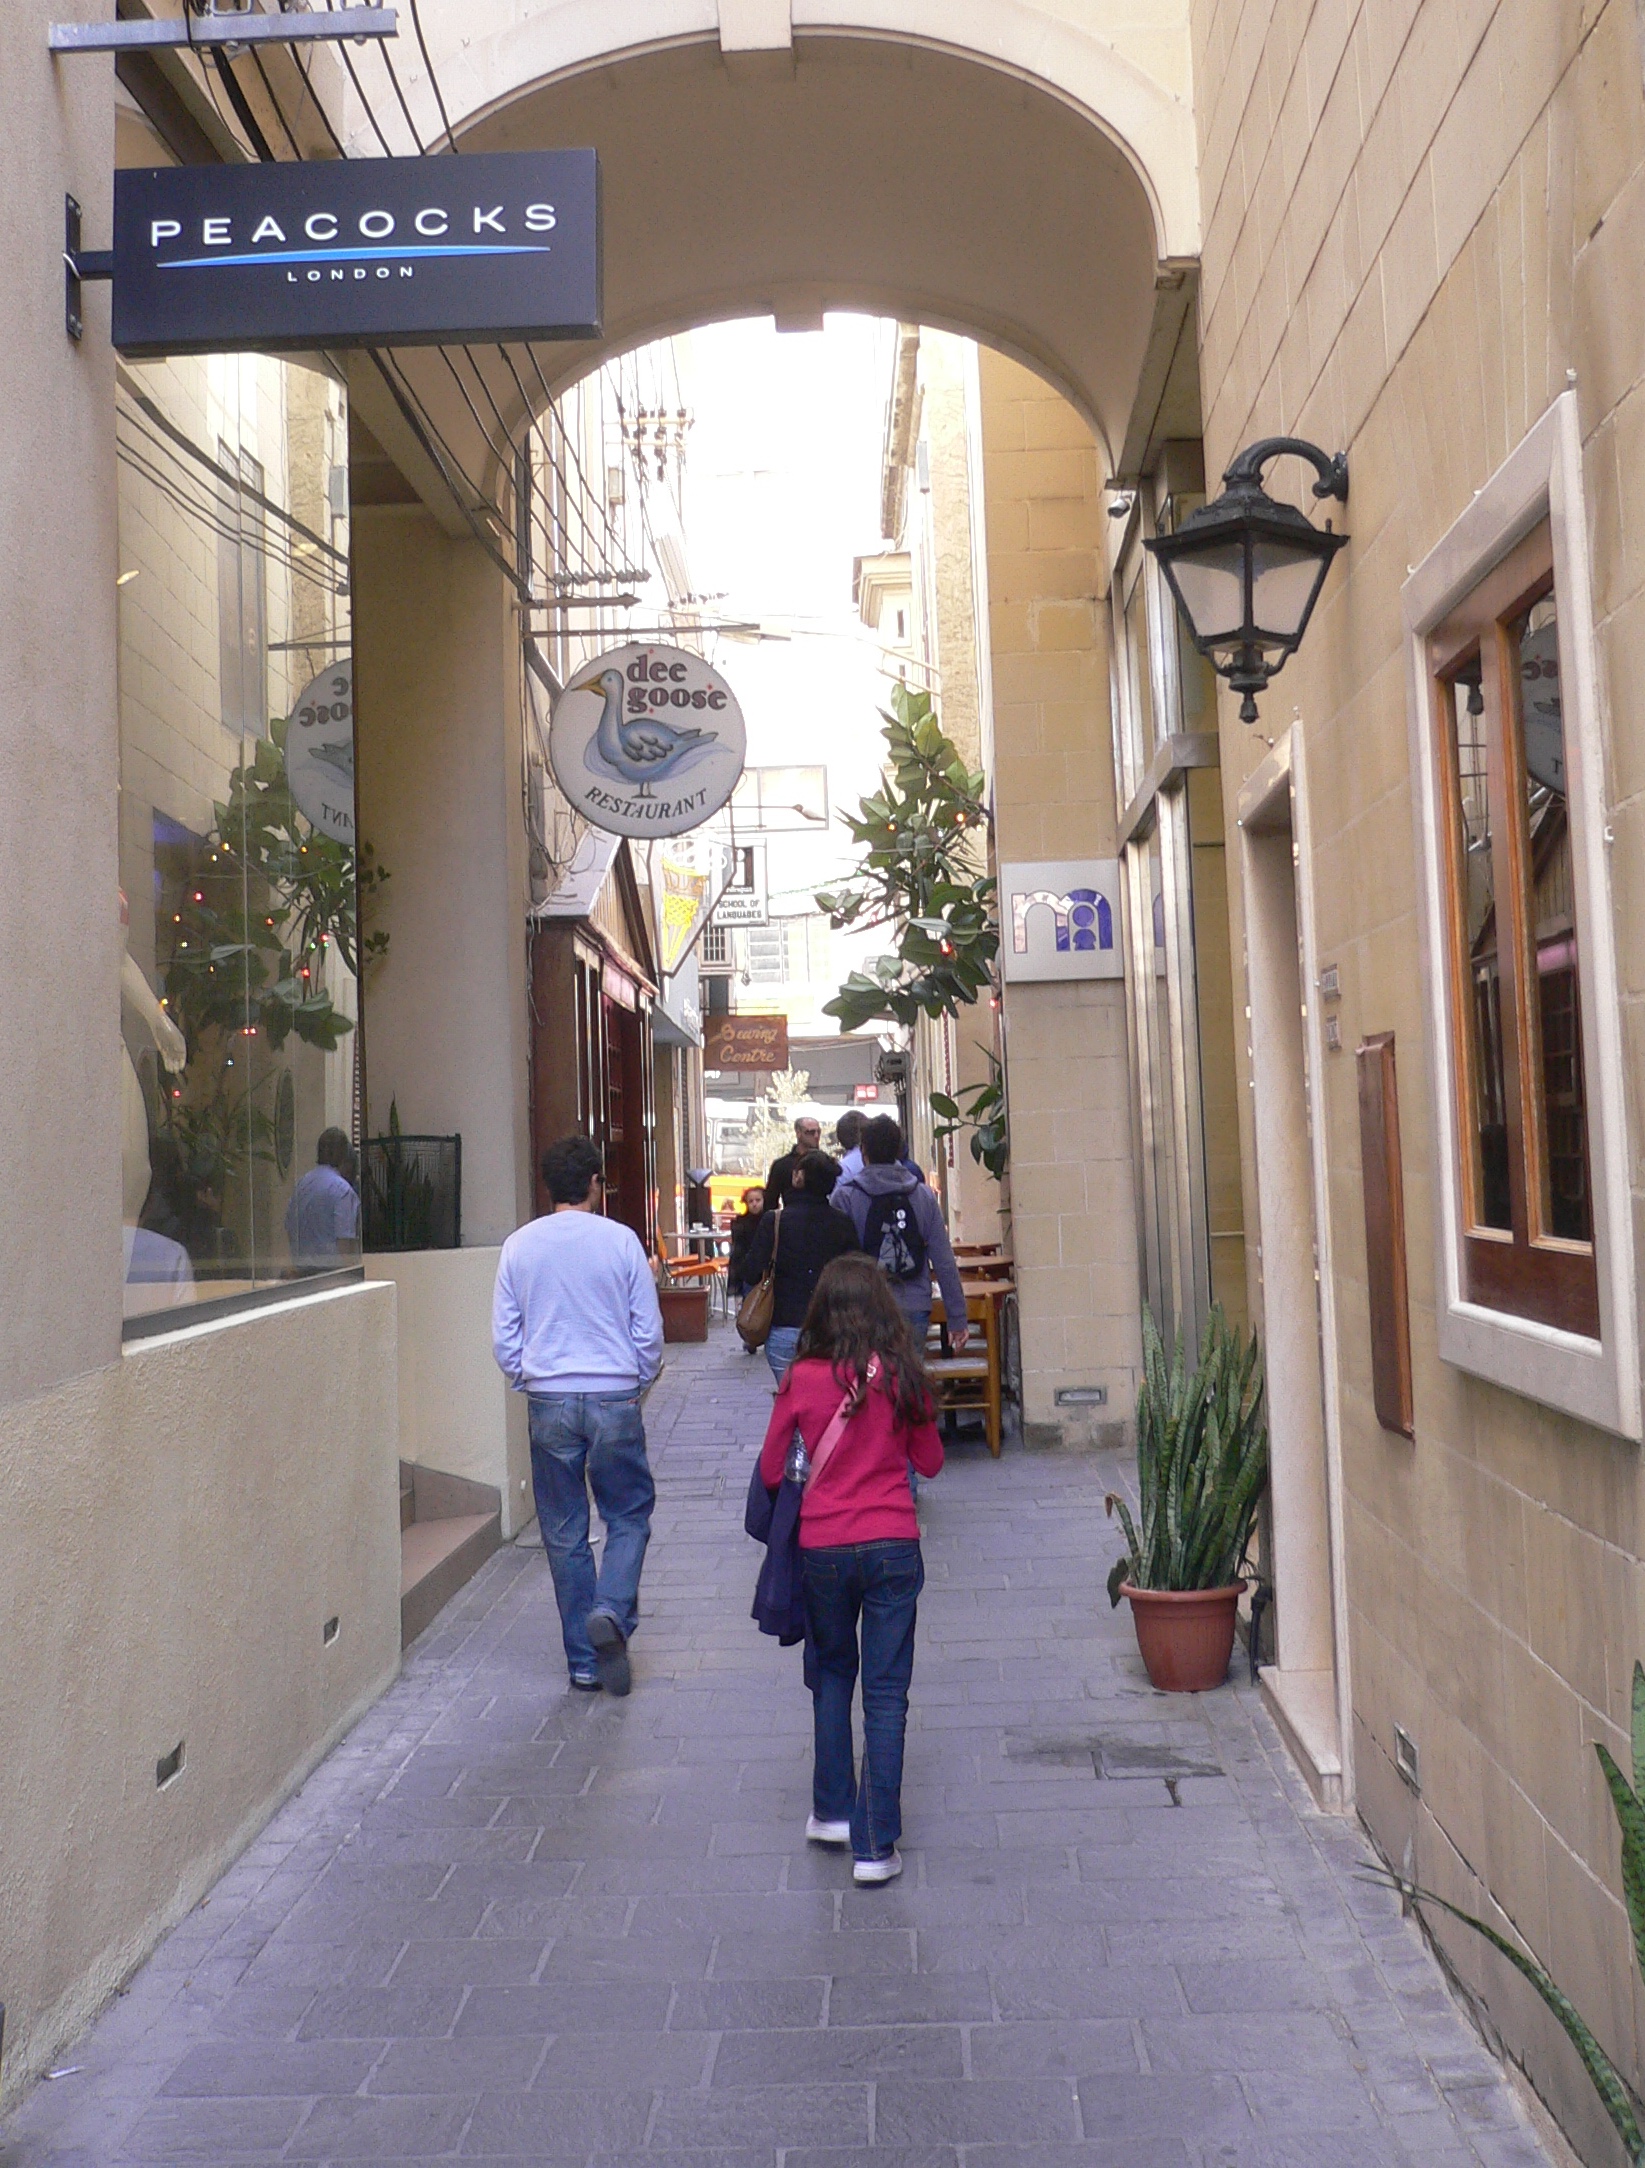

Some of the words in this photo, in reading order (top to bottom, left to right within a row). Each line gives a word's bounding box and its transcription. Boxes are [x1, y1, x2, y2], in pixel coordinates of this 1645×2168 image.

[150, 203, 558, 248] PEACOCKS
[286, 266, 415, 283] LONDON
[626, 654, 688, 683] dee
[626, 687, 728, 714] goose
[584, 785, 708, 820] RESTAURANT
[716, 910, 762, 920] LANGUAGES
[719, 899, 748, 909] SCHOOL
[749, 899, 761, 908] OF
[720, 1044, 777, 1063] Centre
